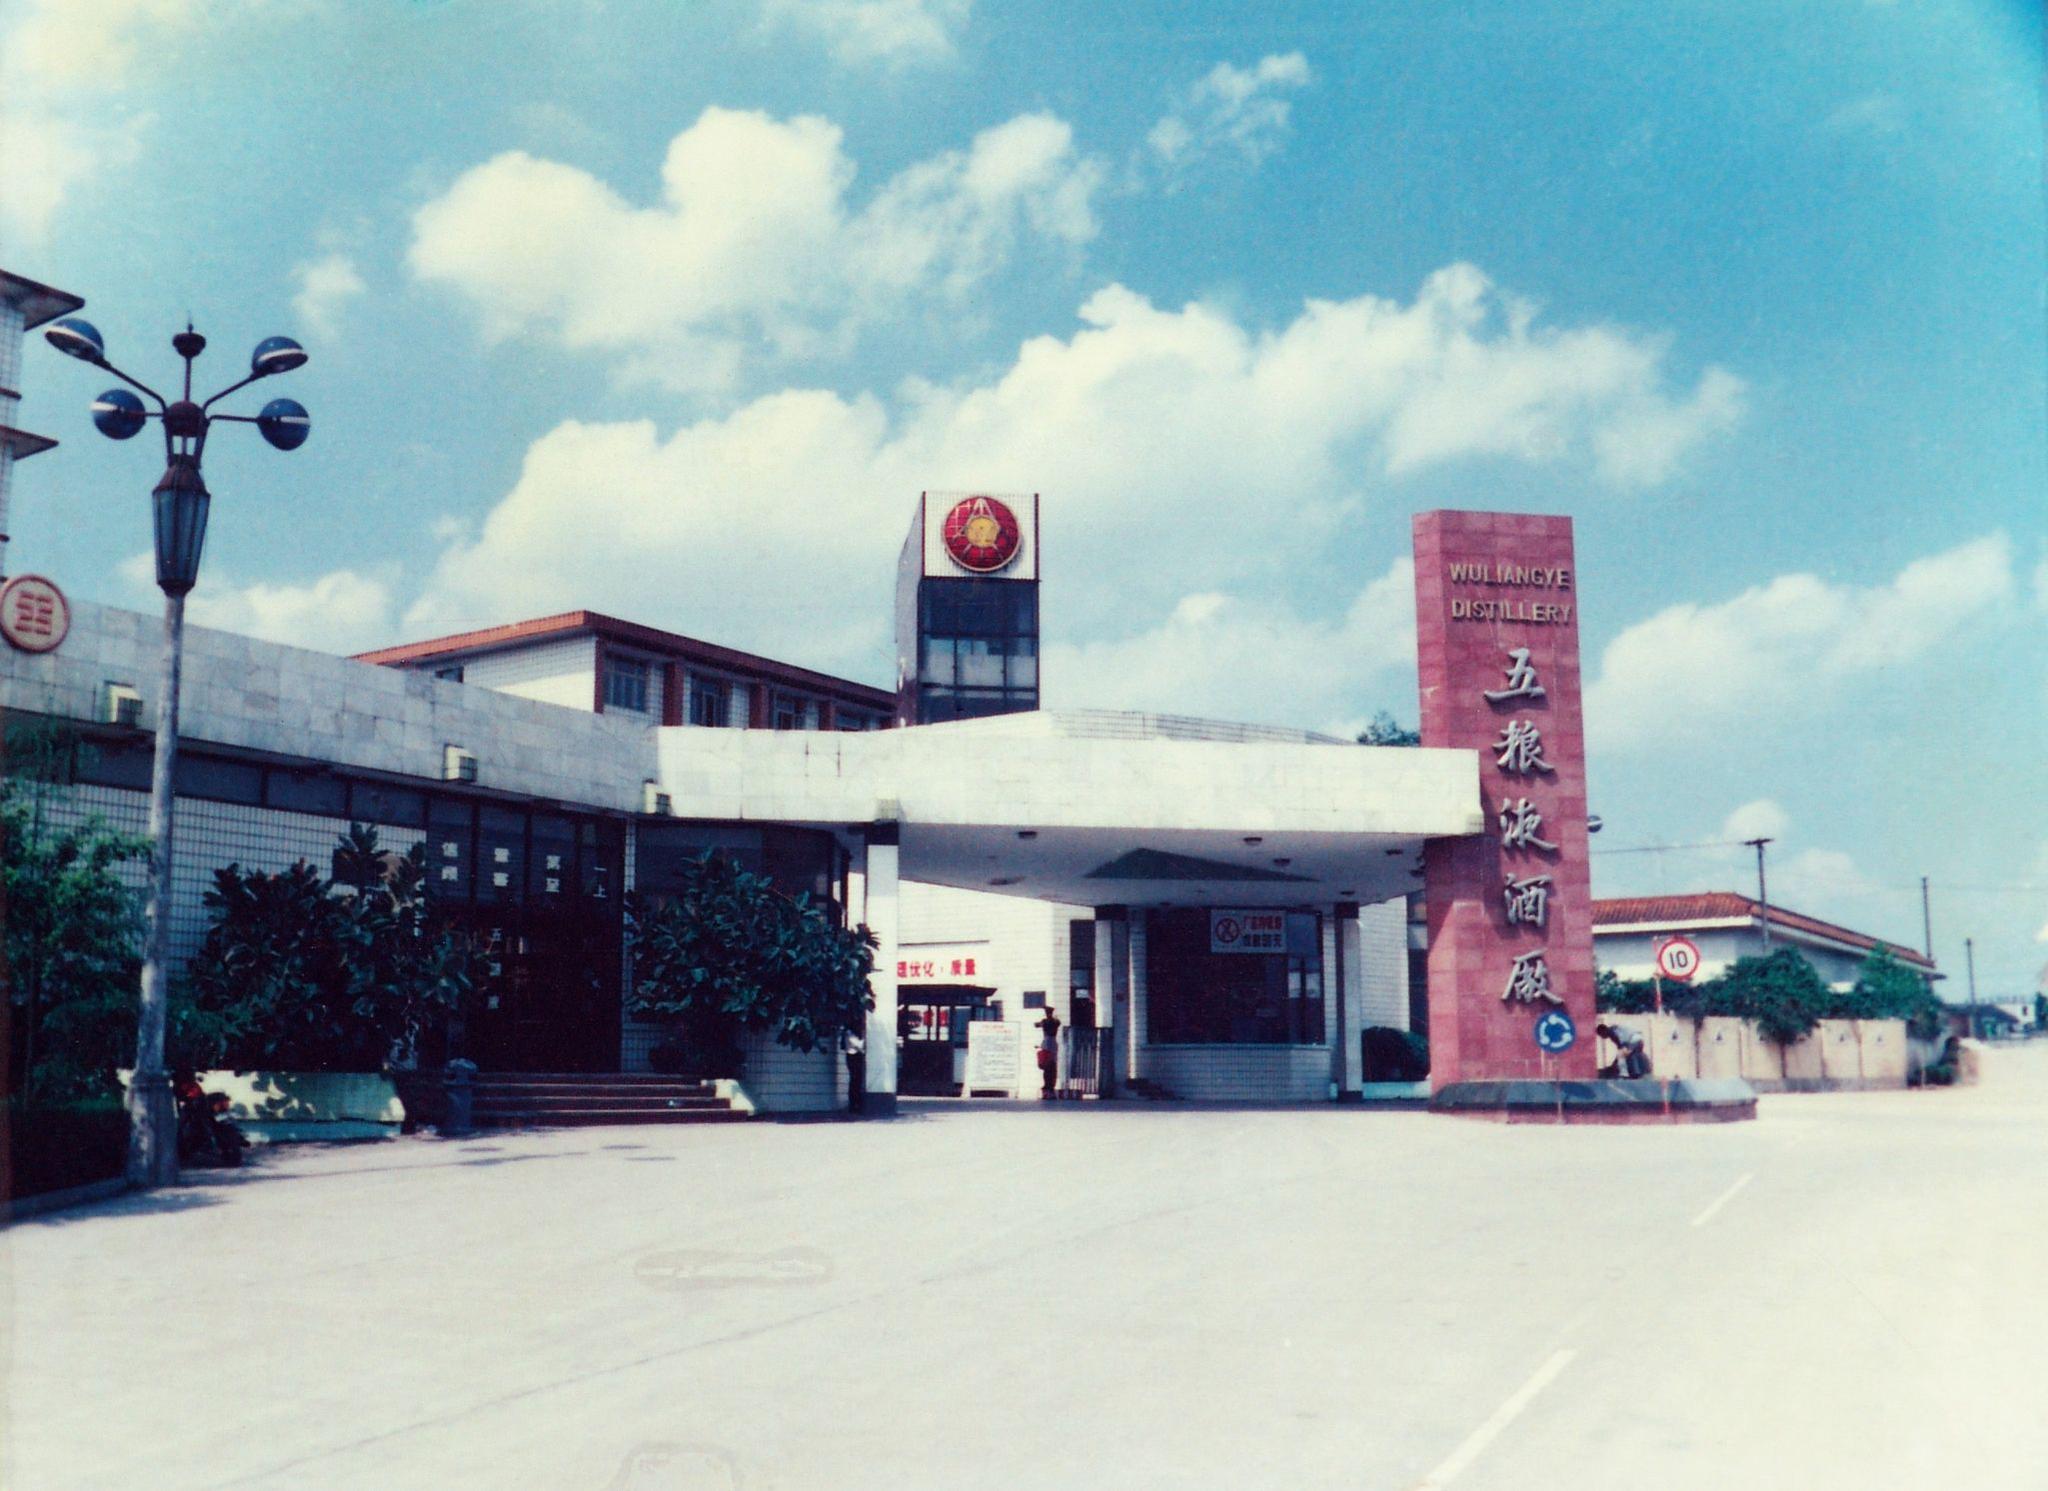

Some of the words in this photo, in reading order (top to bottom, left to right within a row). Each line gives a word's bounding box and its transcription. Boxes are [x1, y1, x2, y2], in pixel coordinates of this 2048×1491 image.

[1450, 563, 1569, 587] WULIANGYE
[1452, 599, 1571, 622] DISTILLERY
[1669, 950, 1688, 969] 10
